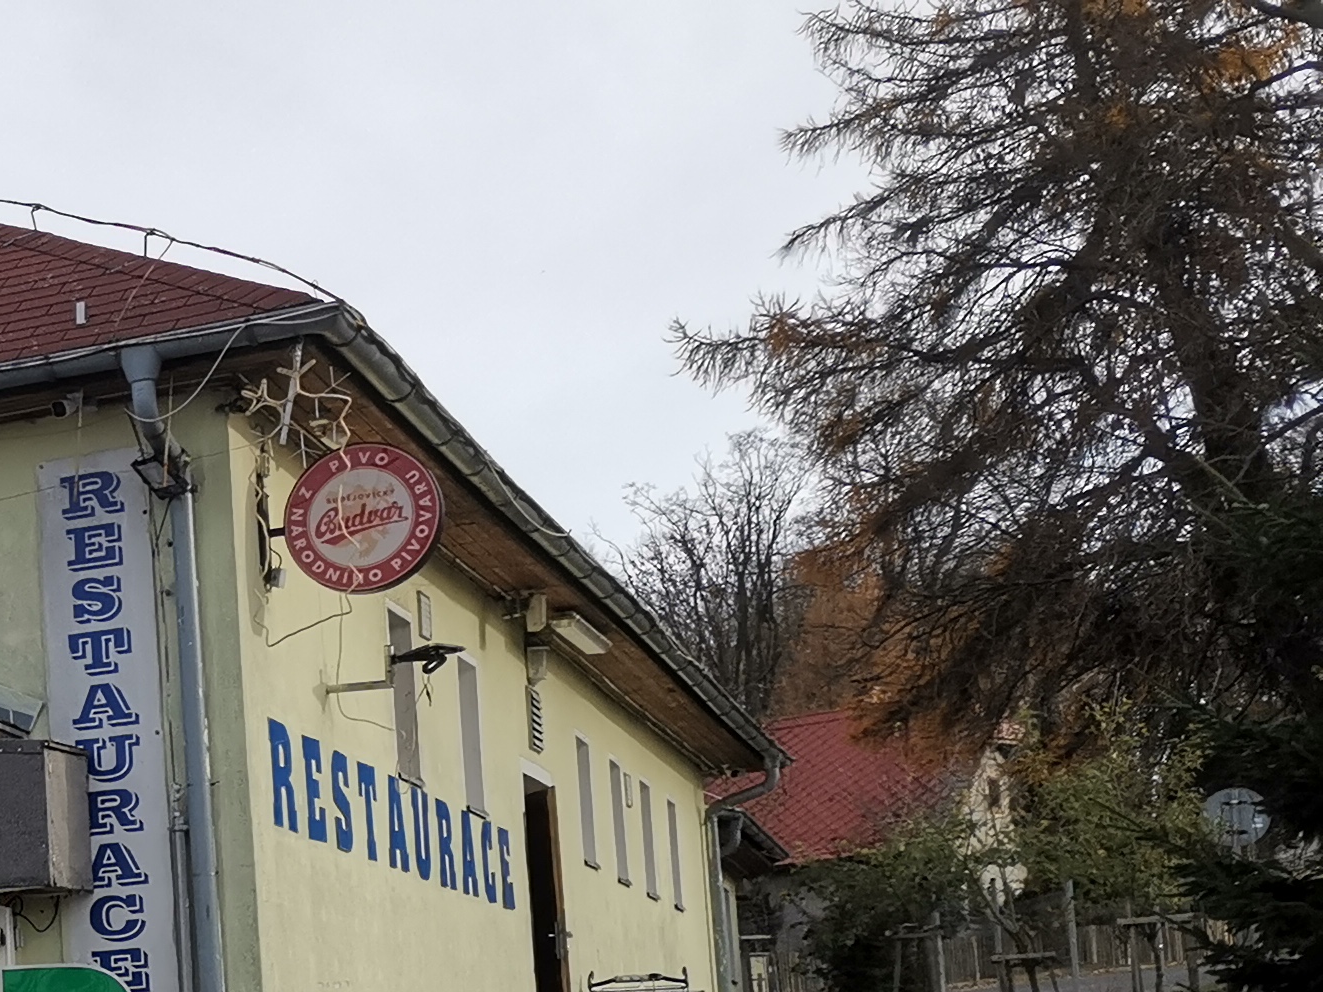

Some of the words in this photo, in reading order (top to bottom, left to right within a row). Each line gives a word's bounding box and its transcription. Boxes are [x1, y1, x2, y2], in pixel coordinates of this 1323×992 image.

[299, 486, 312, 499] Z
[315, 501, 409, 541] Budvar
[390, 470, 433, 571] PIVOVARU
[291, 507, 382, 584] NÁRODNÍHO
[267, 717, 516, 911] RESTAURACE
